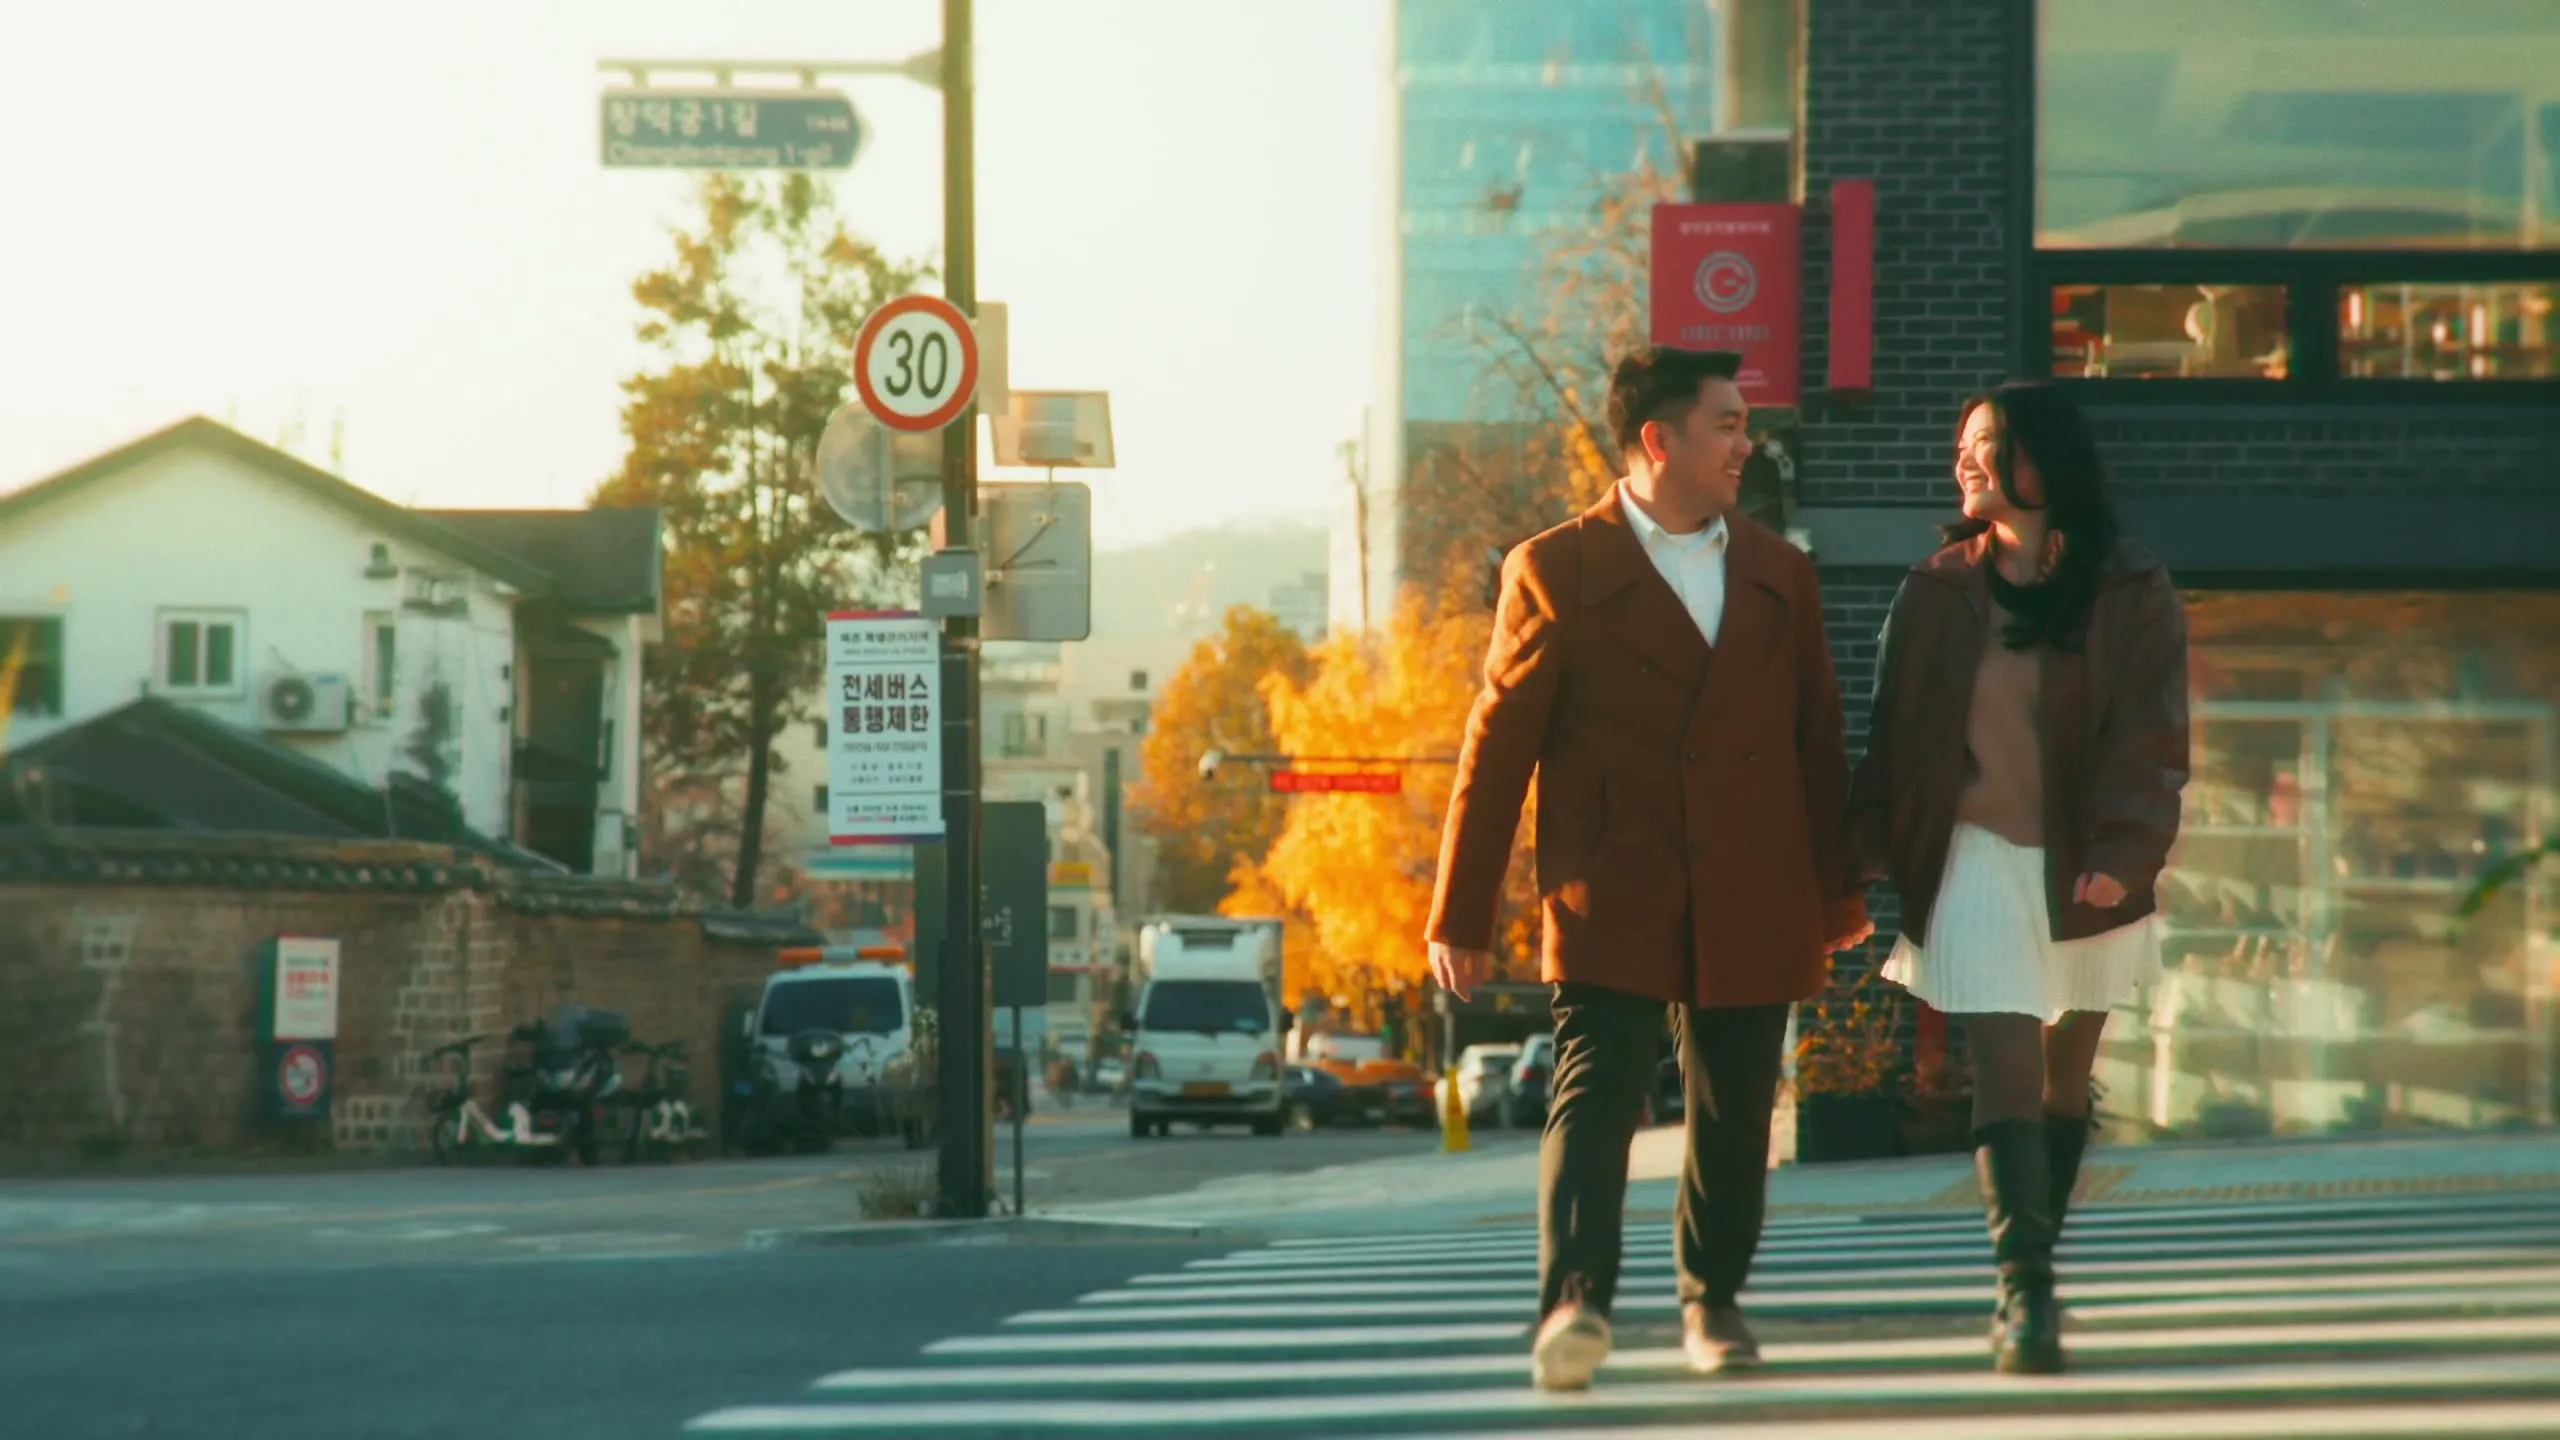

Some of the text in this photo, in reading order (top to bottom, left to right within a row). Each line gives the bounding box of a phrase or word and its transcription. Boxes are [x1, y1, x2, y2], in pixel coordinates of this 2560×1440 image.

[884, 329, 947, 398] 30
[842, 673, 929, 701] 전세버스
[842, 704, 929, 734] 통행제한
